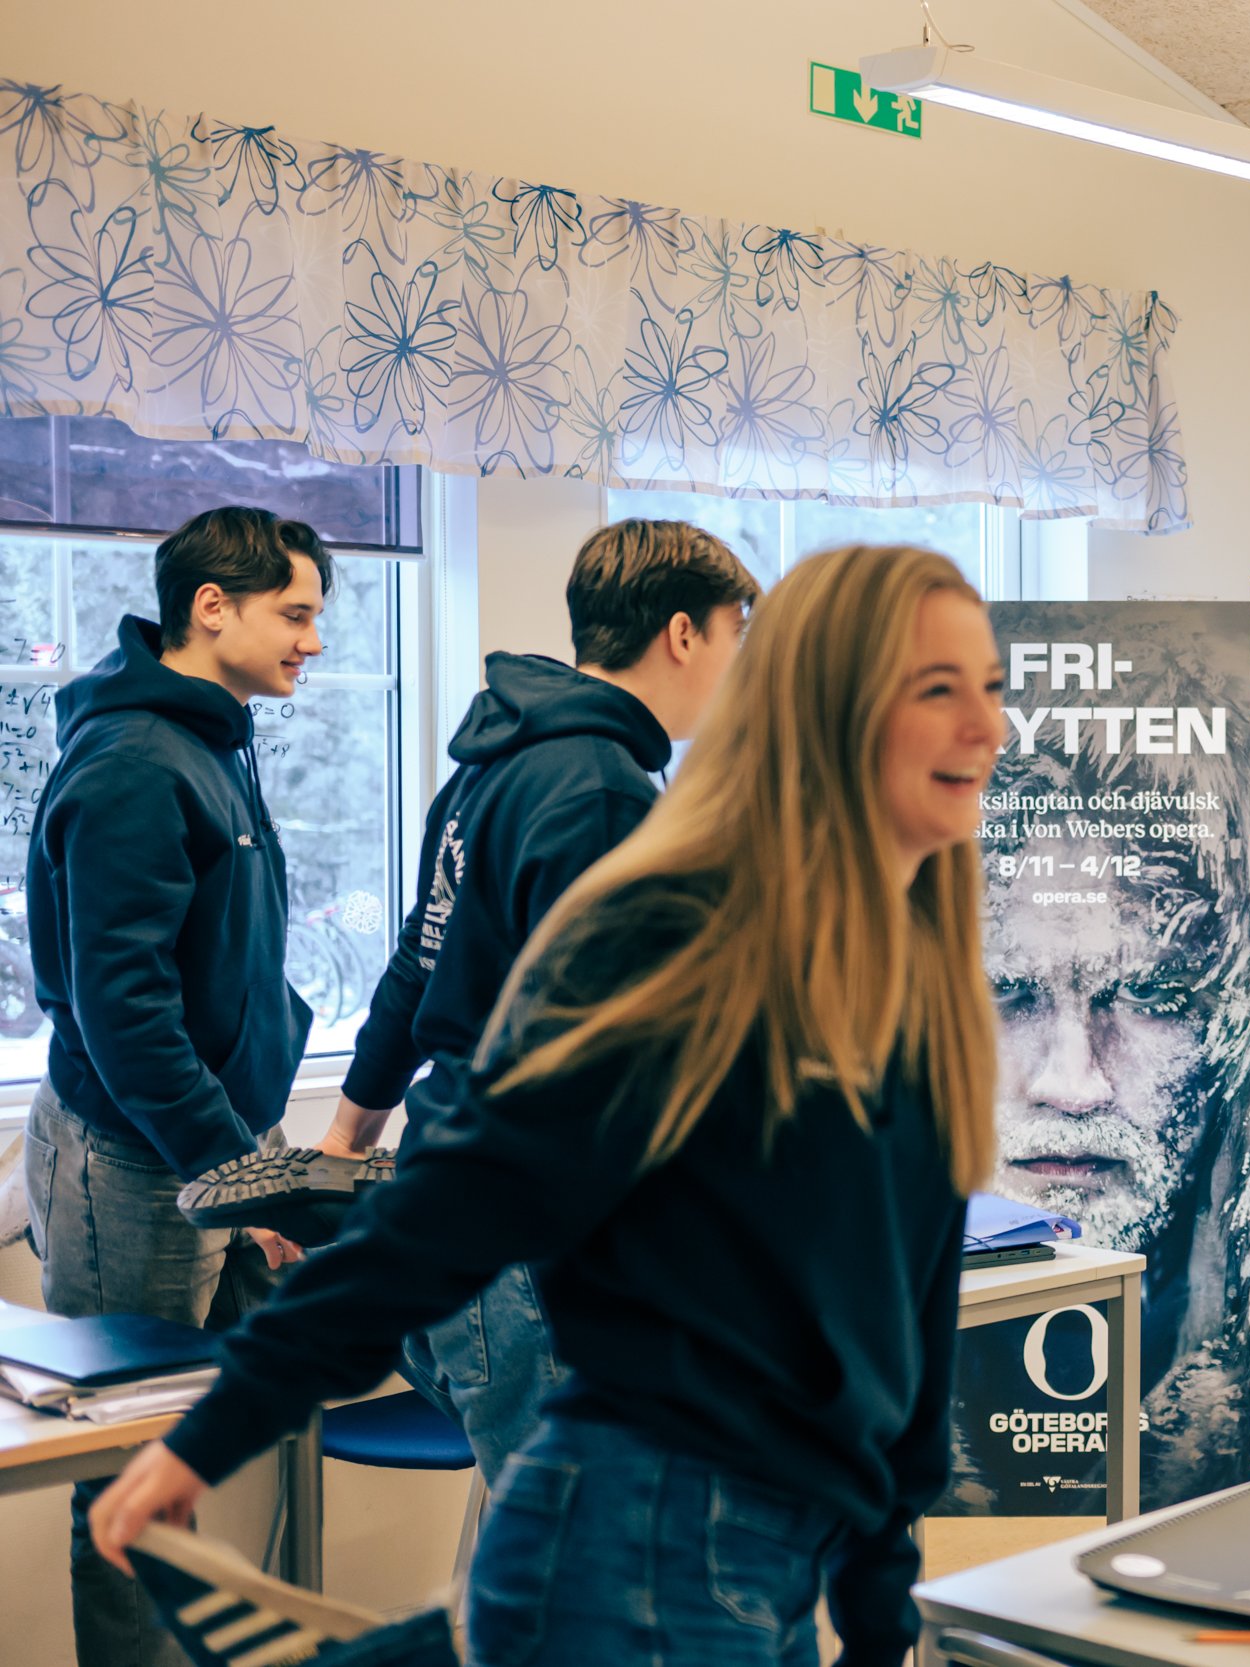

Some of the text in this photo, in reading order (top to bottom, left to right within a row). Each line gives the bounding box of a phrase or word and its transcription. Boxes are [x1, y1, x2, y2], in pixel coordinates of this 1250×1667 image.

[1009, 642, 1133, 690] FRI-
[996, 707, 1226, 755] YTTEN
[979, 792, 1220, 815] kslängtan och djävulsk
[1010, 819, 1018, 838] i
[1022, 824, 1062, 839] von
[1066, 820, 1145, 839] Webers
[1149, 824, 1216, 843] opera.
[999, 855, 1054, 879] 8/11
[1081, 855, 1142, 879] 4/12
[1032, 891, 1108, 906] opera.se
[989, 1408, 1150, 1433] GÖTEBORS
[1012, 1433, 1108, 1453] OPERA
